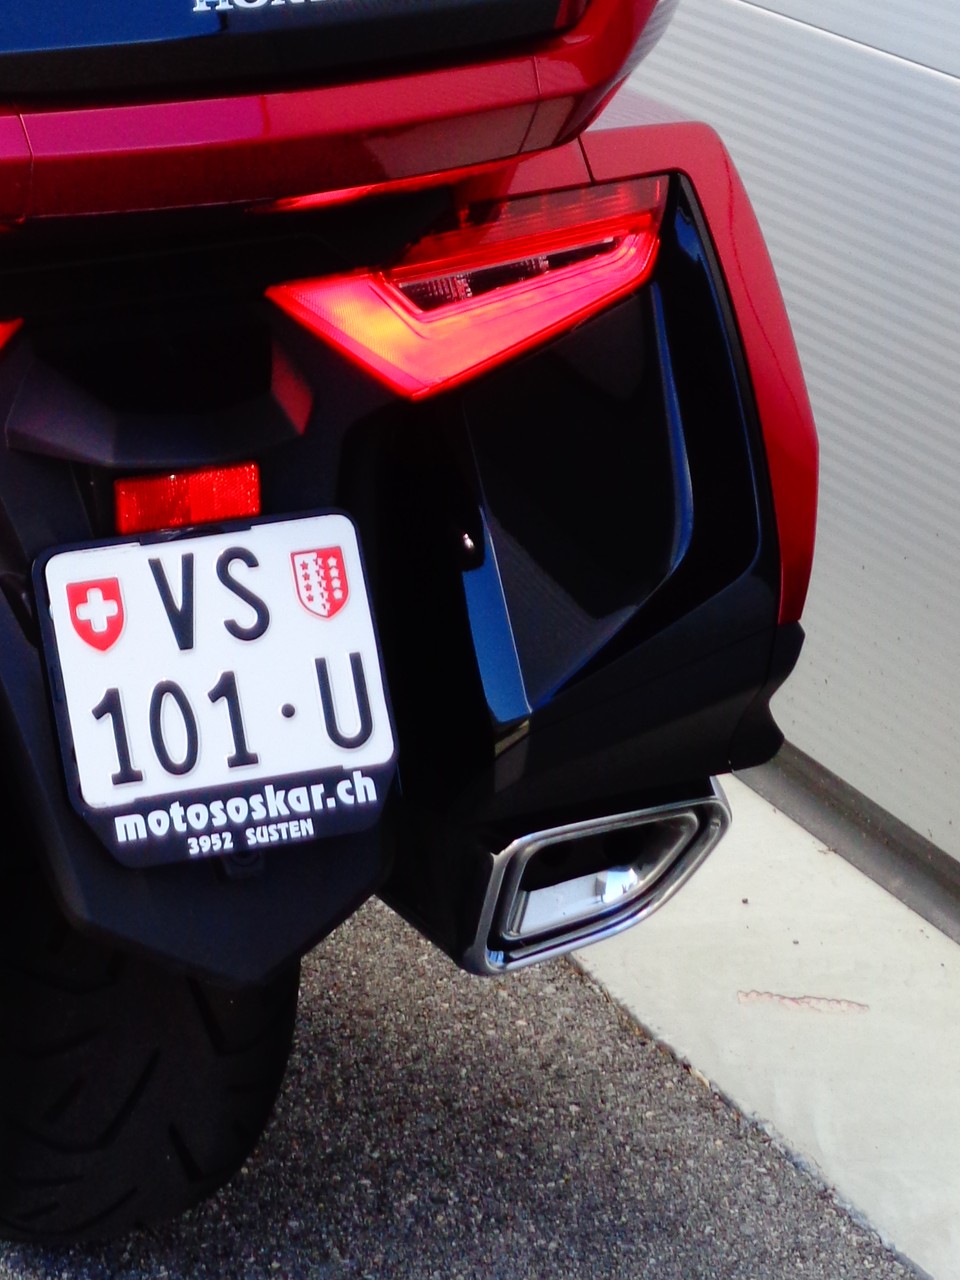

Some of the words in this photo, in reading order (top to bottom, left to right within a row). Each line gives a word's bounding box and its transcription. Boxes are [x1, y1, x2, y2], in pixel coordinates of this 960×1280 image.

[148, 546, 270, 651] VS
[114, 770, 378, 843] motososkar.ch
[187, 831, 234, 855] 3952
[245, 818, 315, 845] SUSTEN
